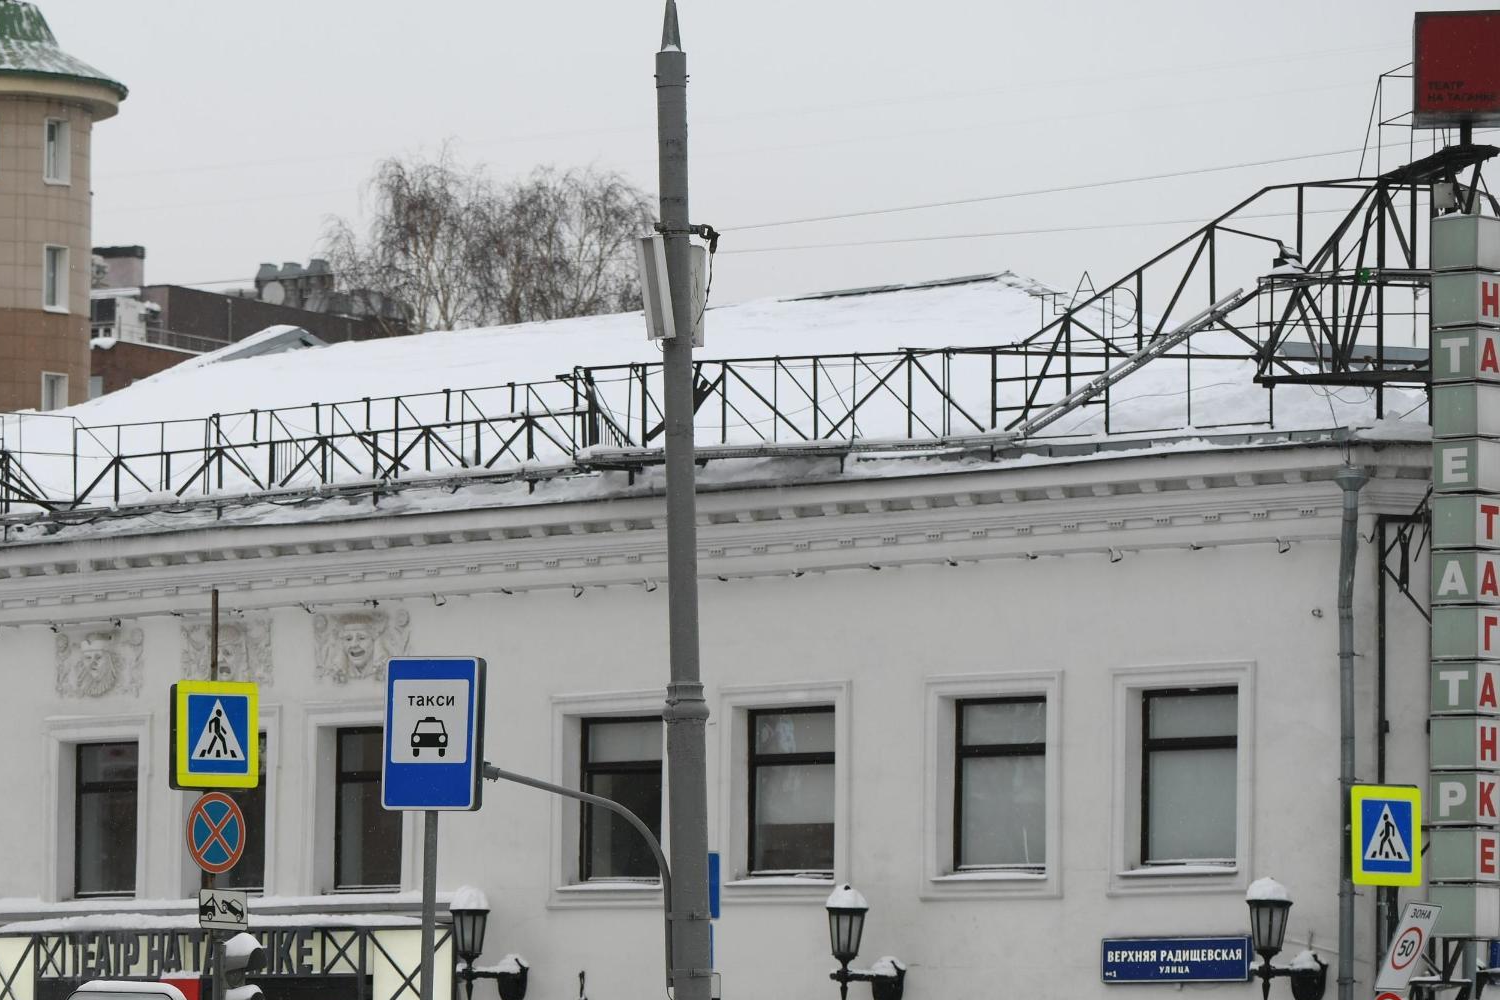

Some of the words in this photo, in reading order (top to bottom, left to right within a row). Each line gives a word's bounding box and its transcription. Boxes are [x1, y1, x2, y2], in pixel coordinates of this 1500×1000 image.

[408, 696, 454, 706] такси
[1410, 908, 1432, 920] ЗОНА
[1398, 940, 1414, 956] 50
[1107, 950, 1156, 962] ВЕРХНЯЯ
[1160, 949, 1242, 963] РАДИЩЕВСКАЯ
[1160, 966, 1190, 974] УЛИЦА
